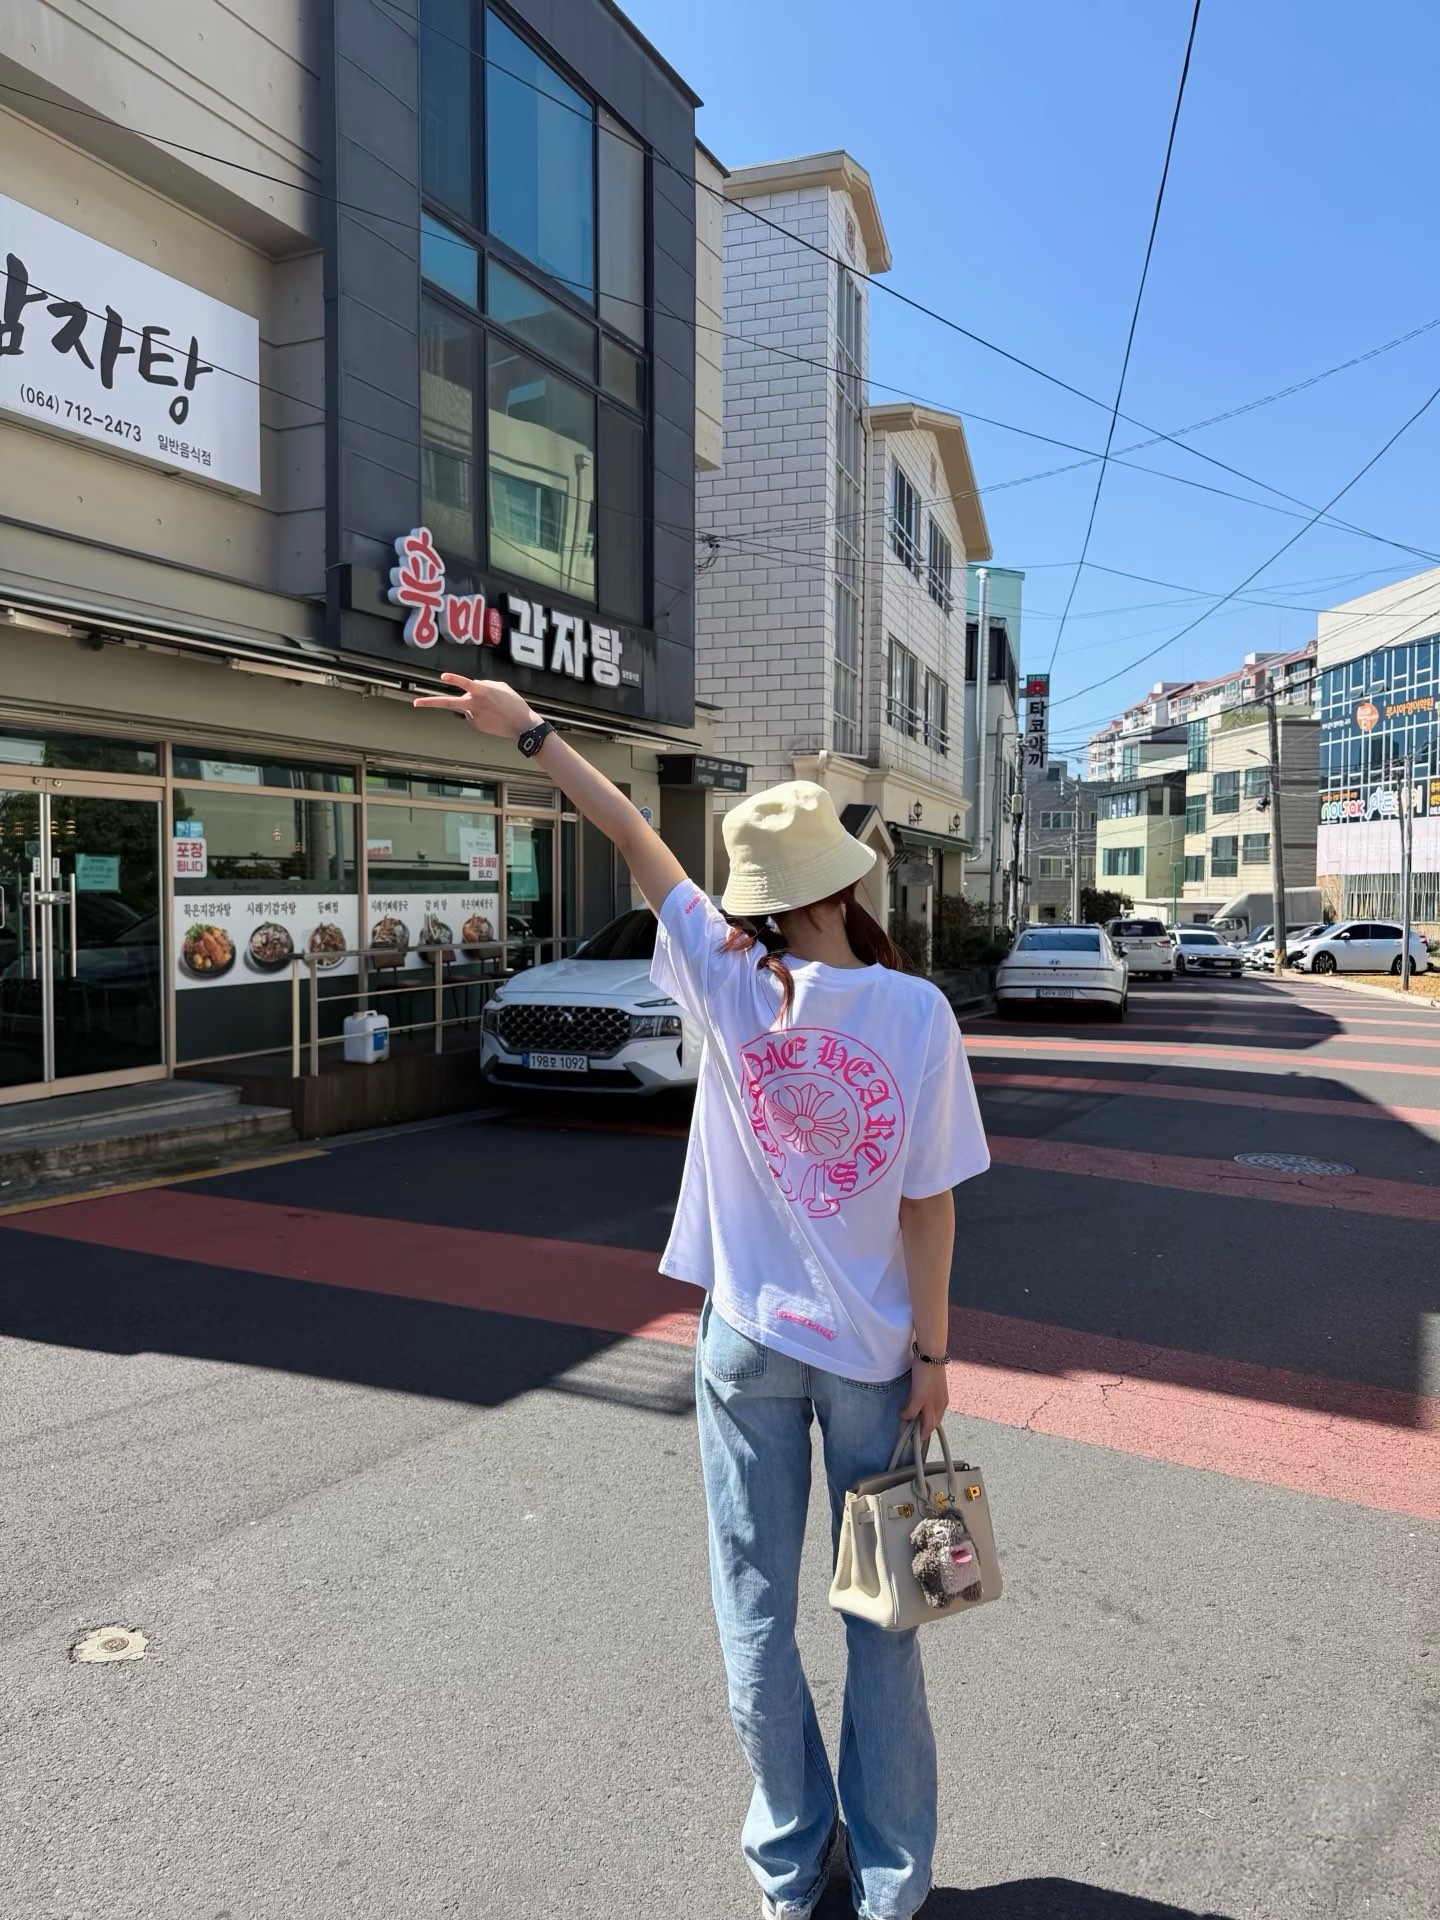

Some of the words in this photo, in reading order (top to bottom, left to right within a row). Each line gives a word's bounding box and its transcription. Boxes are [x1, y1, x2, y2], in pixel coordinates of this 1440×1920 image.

[20, 383, 60, 414] (064)
[64, 400, 142, 442] 712-2473
[157, 434, 212, 467] 일반음식점
[508, 595, 623, 688] 감자탕
[1028, 701, 1046, 769] 타코야끼
[176, 842, 204, 858] 포장
[177, 860, 204, 873] 됩니다
[184, 902, 231, 917] 묵은지감자탕
[246, 901, 297, 916] 시래기감자탕
[560, 1056, 585, 1070] 1092
[812, 1034, 897, 1193] HEARTS
